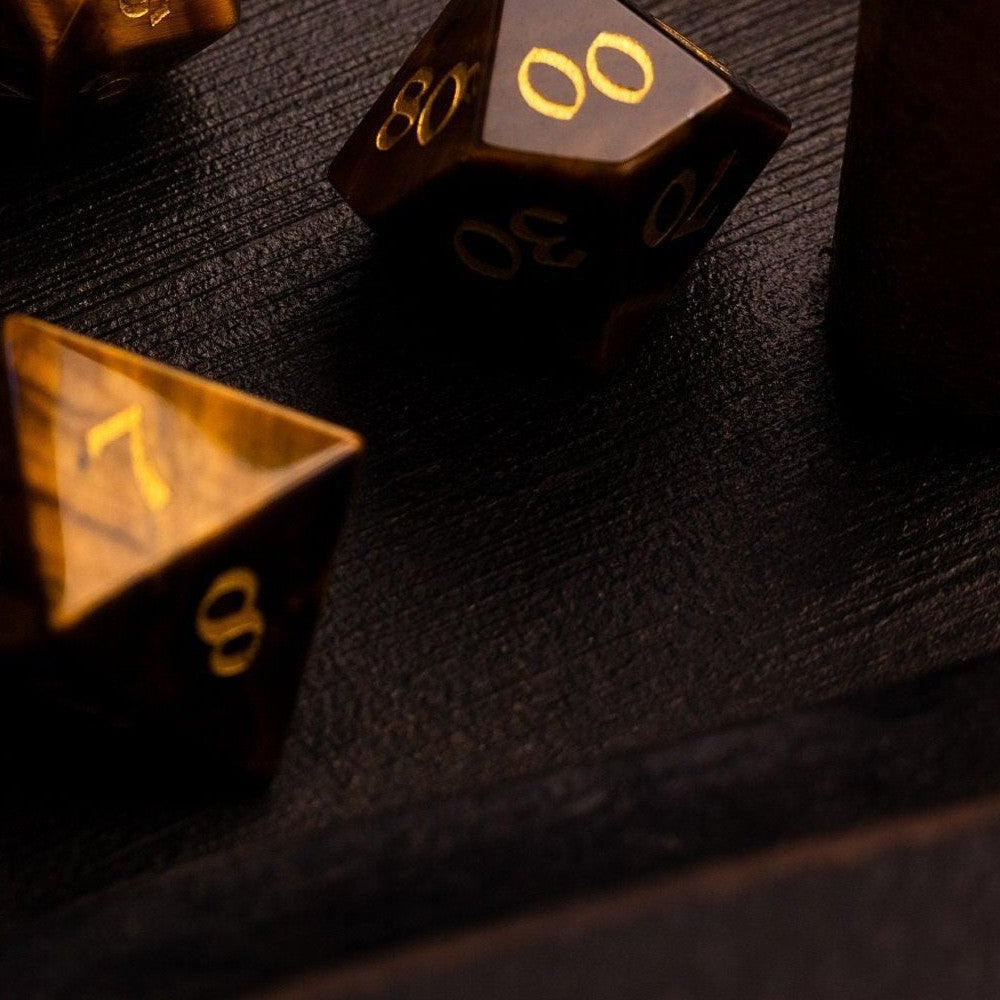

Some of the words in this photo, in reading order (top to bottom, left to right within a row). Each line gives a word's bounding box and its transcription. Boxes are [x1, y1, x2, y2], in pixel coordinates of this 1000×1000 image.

[375, 62, 466, 152] 80
[517, 30, 655, 122] 00
[85, 403, 171, 512] 7
[194, 565, 267, 679] 8
